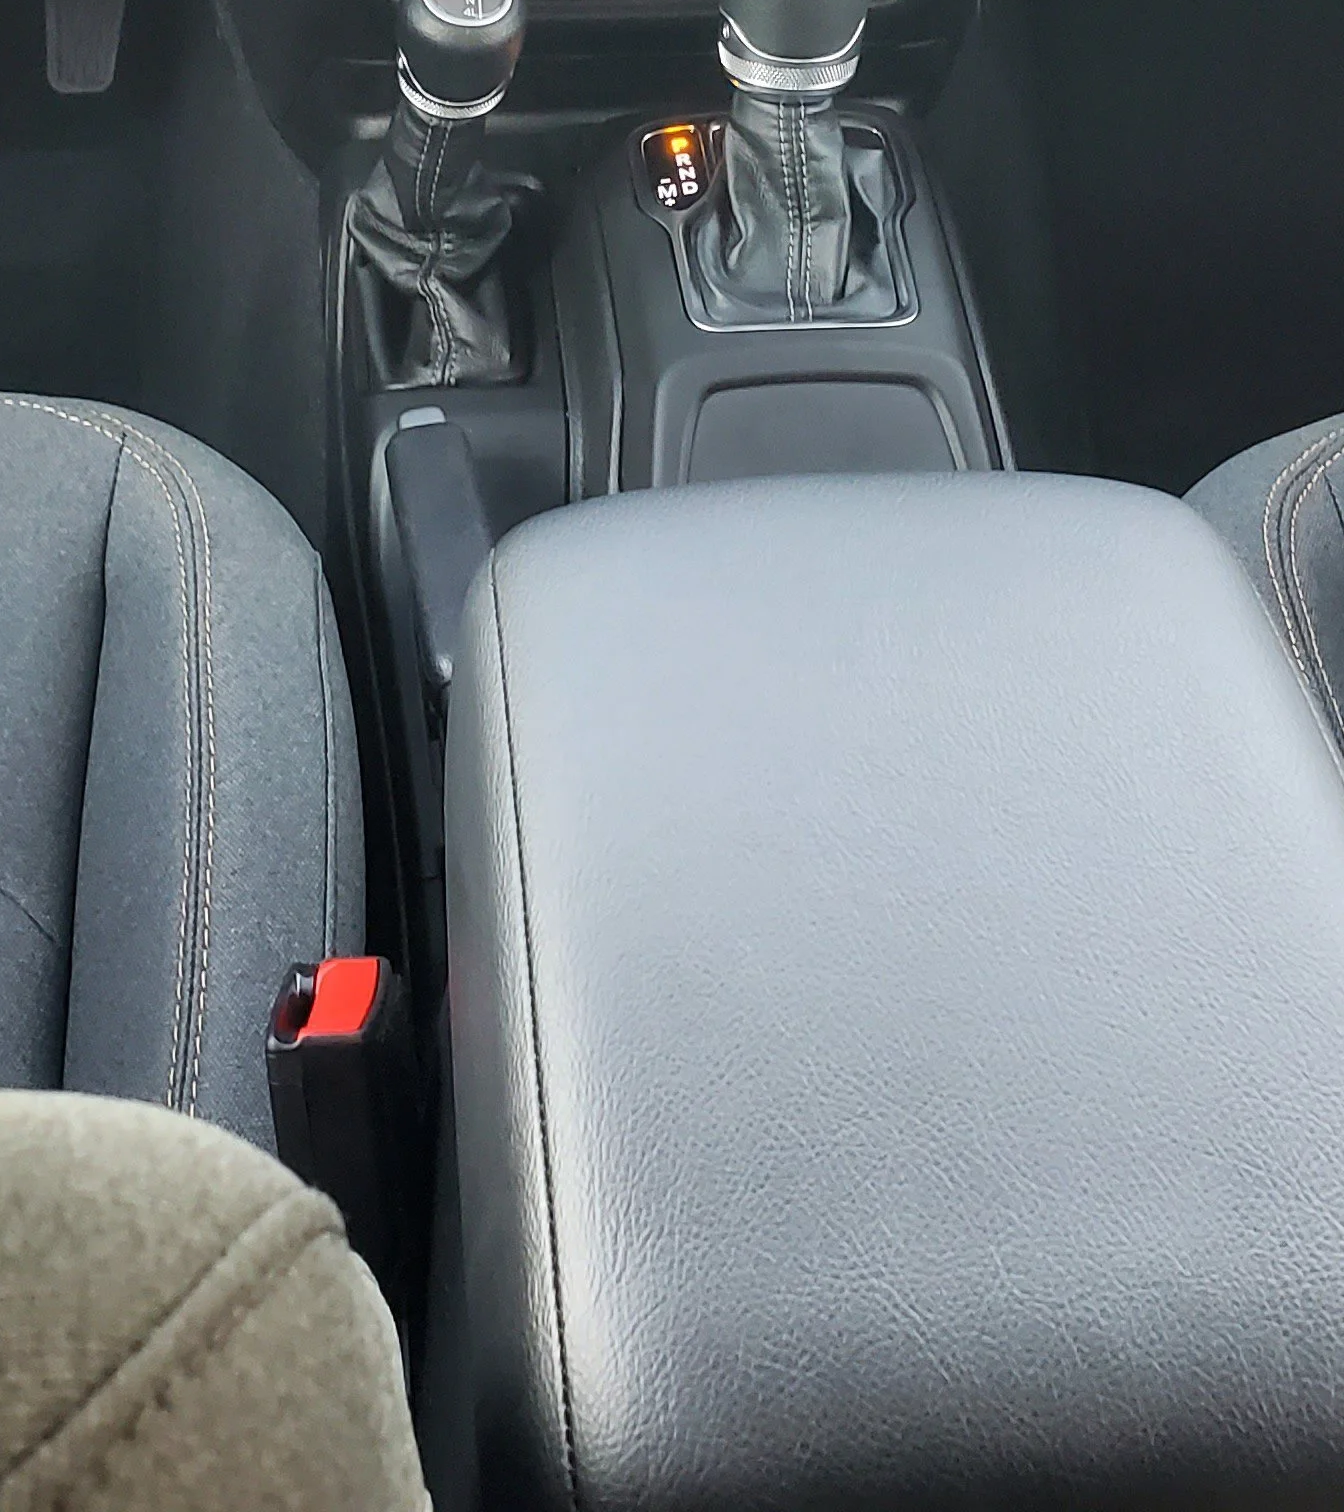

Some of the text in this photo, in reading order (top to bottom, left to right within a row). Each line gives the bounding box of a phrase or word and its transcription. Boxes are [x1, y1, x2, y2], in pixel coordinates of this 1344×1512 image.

[463, 7, 478, 18] 4L
[671, 137, 689, 154] P
[675, 153, 692, 167] R
[678, 166, 696, 181] N
[657, 183, 678, 199] M
[681, 181, 699, 196] D
